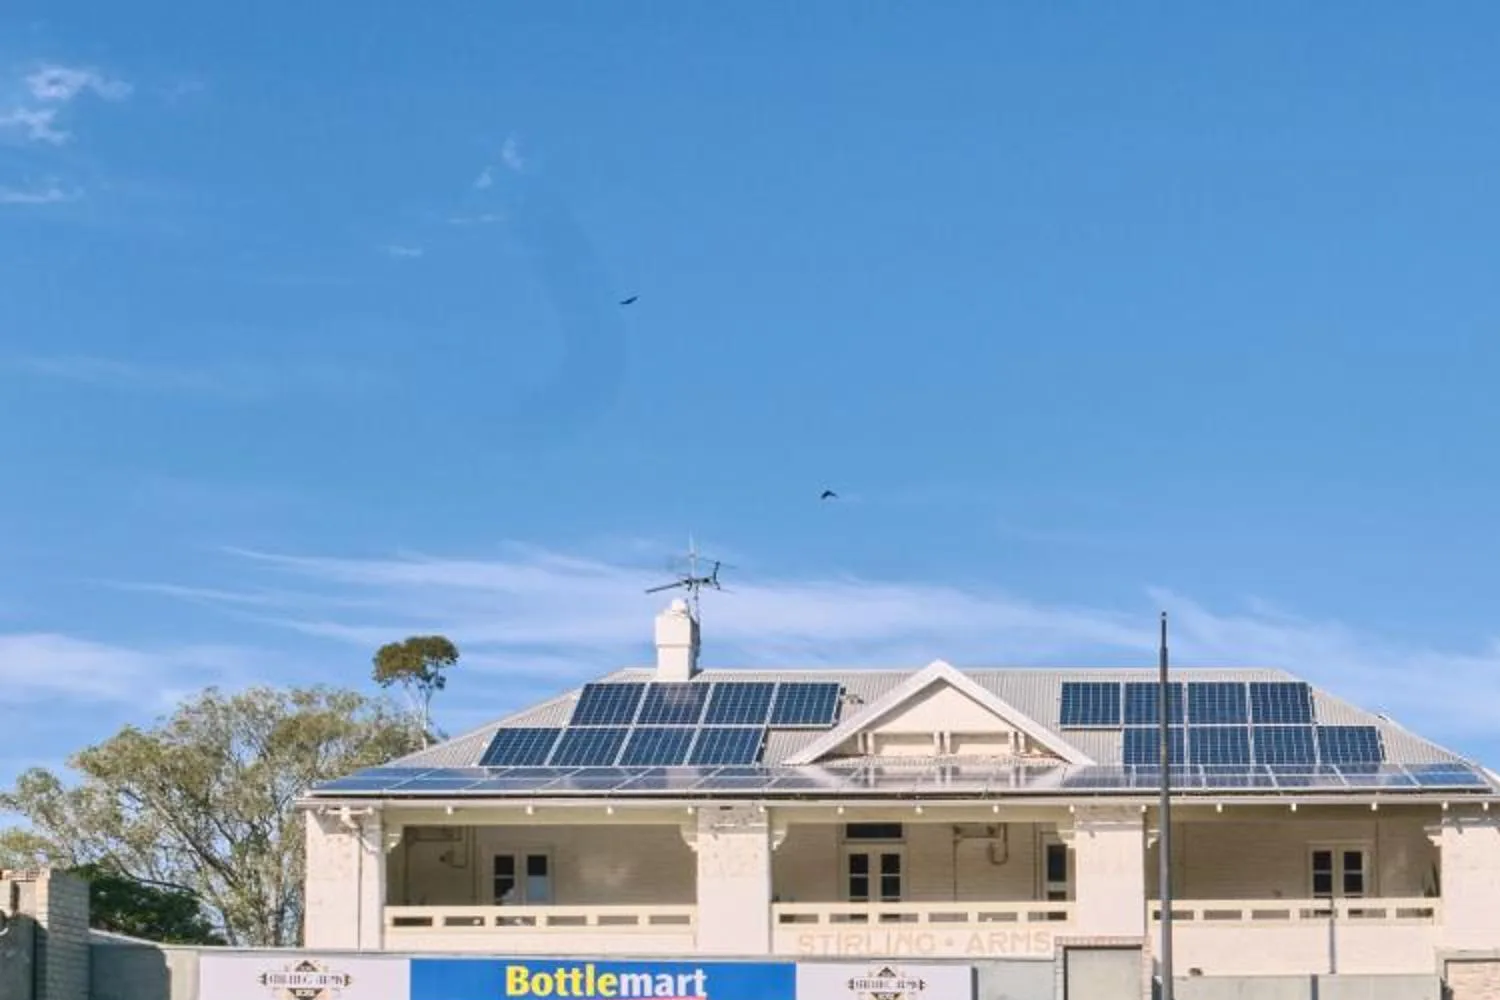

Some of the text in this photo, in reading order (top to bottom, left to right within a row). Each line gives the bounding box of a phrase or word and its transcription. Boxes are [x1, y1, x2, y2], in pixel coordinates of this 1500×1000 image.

[799, 931, 1052, 956] STIRLING ARMS
[505, 963, 708, 997] Bottlemart
